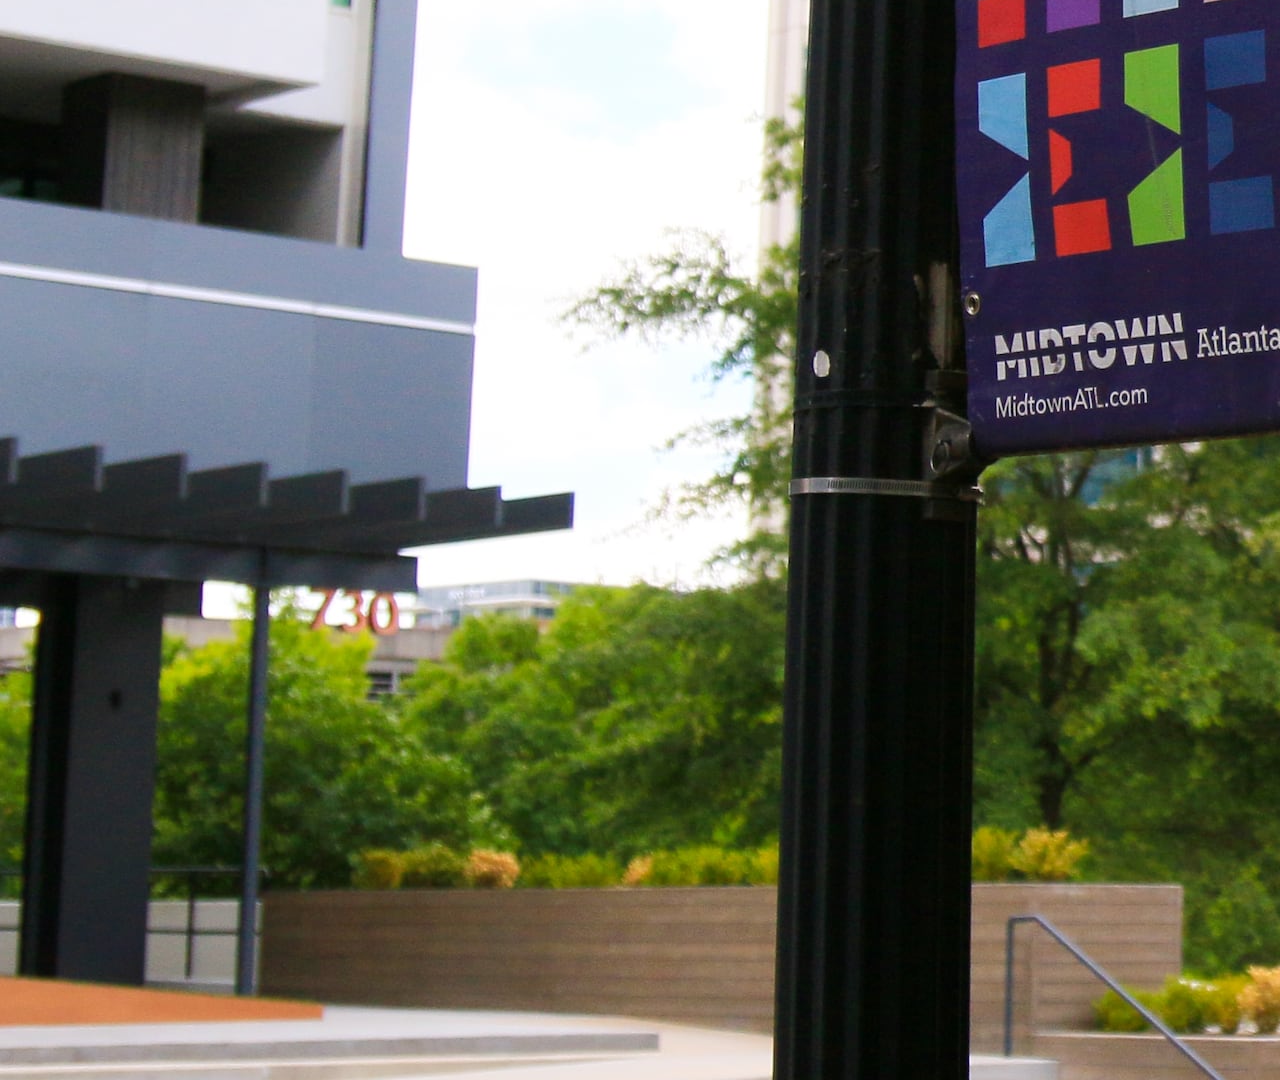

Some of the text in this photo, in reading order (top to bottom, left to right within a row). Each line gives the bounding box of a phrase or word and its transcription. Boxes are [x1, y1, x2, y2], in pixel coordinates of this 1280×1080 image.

[995, 313, 1188, 381] MIDTOWN
[995, 385, 1148, 419] MidtownATL.com
[310, 587, 399, 636] 730
